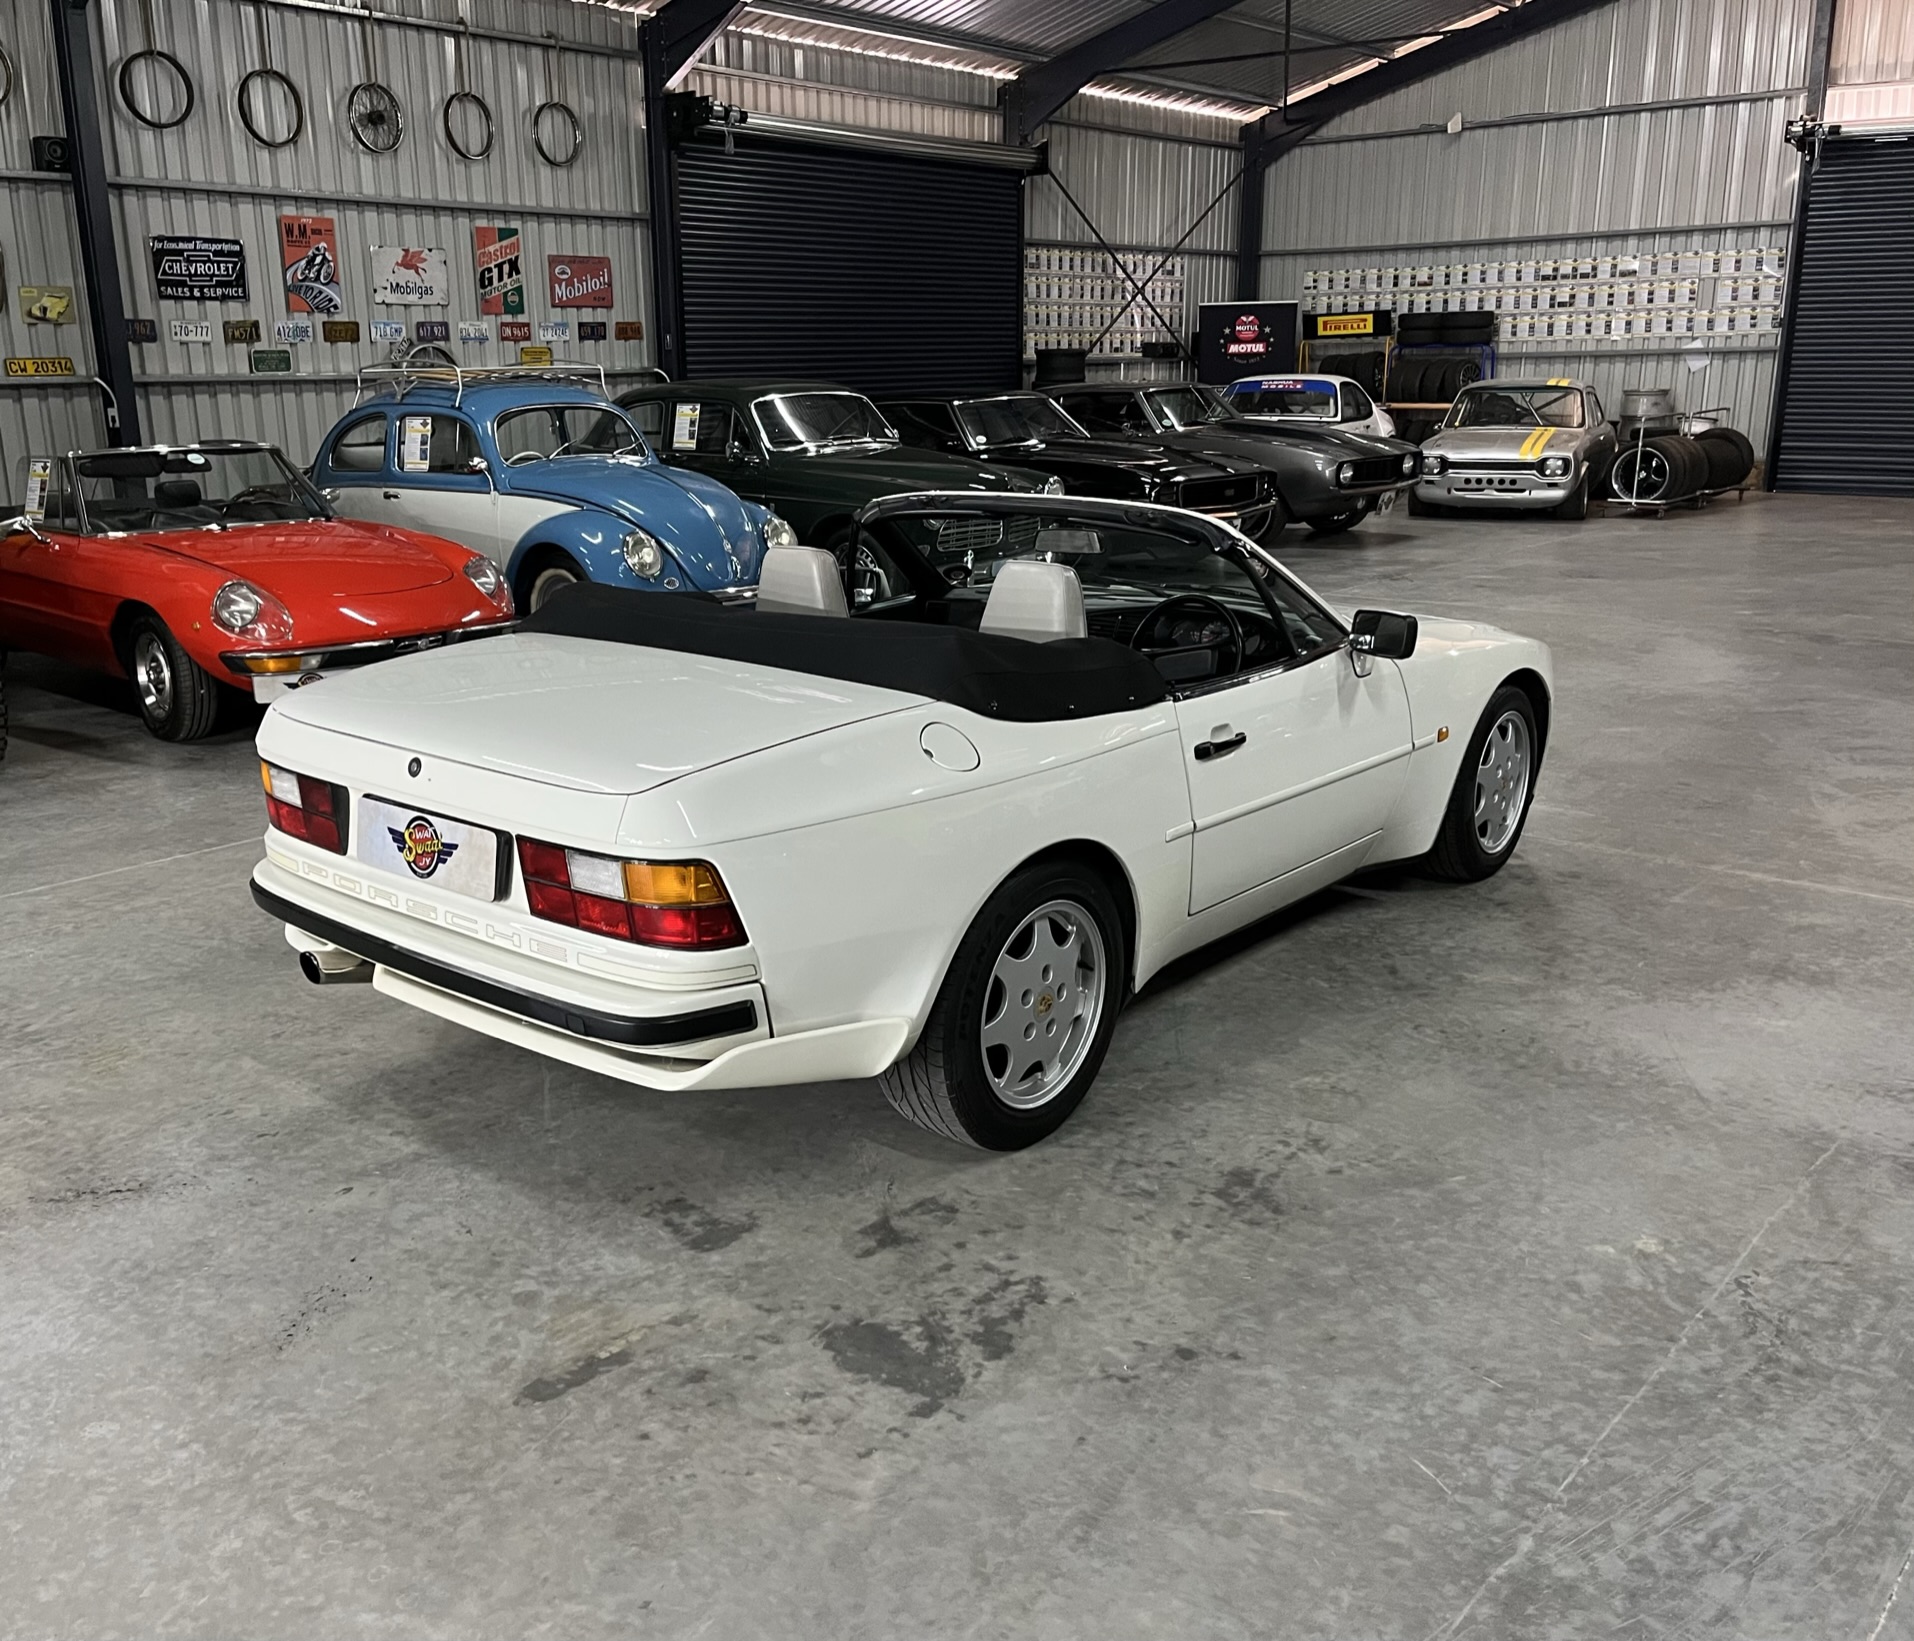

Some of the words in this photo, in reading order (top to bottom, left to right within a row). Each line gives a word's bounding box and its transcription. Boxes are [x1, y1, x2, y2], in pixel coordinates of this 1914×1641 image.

[284, 222, 311, 240] W.M.
[153, 240, 163, 252] for
[478, 237, 520, 268] Castrol
[165, 262, 233, 275] CHEVROLET
[479, 255, 521, 290] GTX
[160, 286, 190, 297] SALES
[193, 288, 201, 297] &
[203, 287, 244, 297] SERVICE
[390, 281, 433, 299] Mobilgas
[480, 282, 508, 300] MOTOR
[509, 277, 522, 287] OIL
[302, 285, 315, 299] TO
[309, 290, 340, 314] RIDE
[1322, 318, 1367, 332] PIRELLI
[1228, 343, 1265, 354] MOTUL
[9, 360, 28, 374] CW
[32, 360, 73, 374] 20314
[419, 857, 432, 866] JY
[303, 861, 568, 963] PORSCHE
